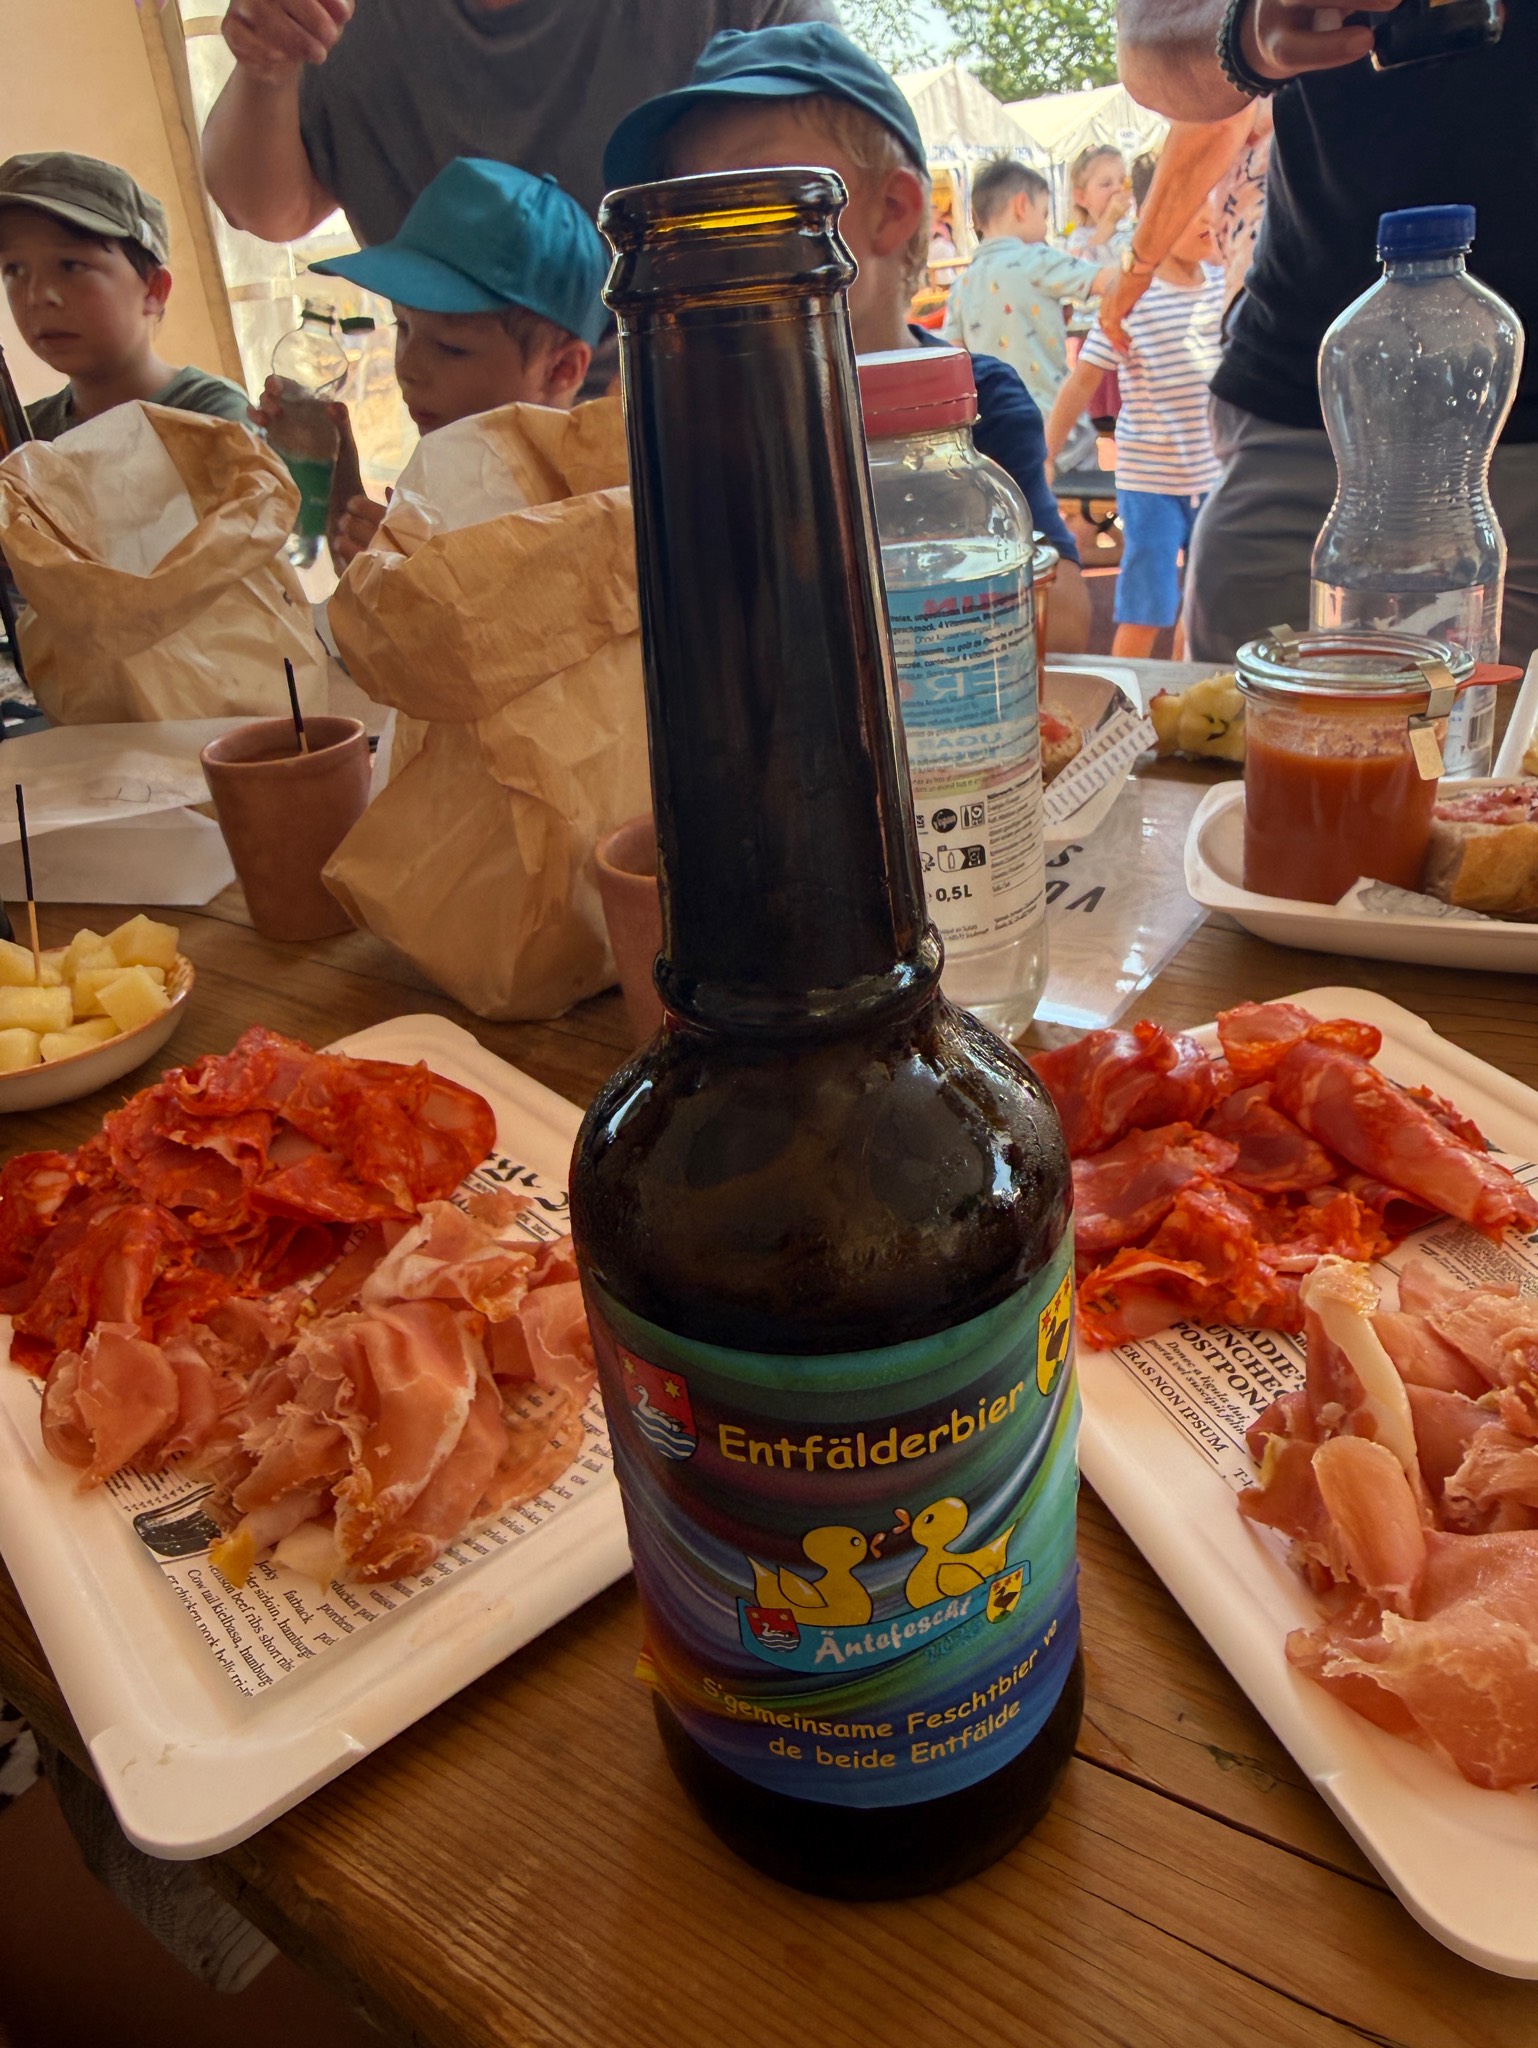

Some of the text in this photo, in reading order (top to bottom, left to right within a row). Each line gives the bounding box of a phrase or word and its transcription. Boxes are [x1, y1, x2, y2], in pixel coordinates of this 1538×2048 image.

[1145, 1339, 1174, 1362] porta
[1172, 1360, 1188, 1379] vel
[1166, 1341, 1195, 1368] Donec
[1200, 1375, 1230, 1402] ligula
[1197, 1319, 1290, 1400] UNCHE
[719, 1381, 1024, 1471] Entfälderbier
[1119, 1344, 1229, 1452] CRAS NON IPSUM
[175, 1587, 202, 1622] chicken
[187, 1569, 207, 1589] Cow
[201, 1589, 221, 1605] tail
[211, 1602, 242, 1649] kielbasa,
[231, 1592, 255, 1612] beef
[245, 1613, 264, 1634] ribs
[259, 1634, 282, 1659] short
[254, 1590, 281, 1621] sirloin,
[283, 1589, 314, 1624] fatback
[814, 1596, 972, 1666] Äntefescht
[703, 1677, 893, 1740] S'gemeinsame
[908, 1650, 1037, 1735] Feschtbier
[769, 1700, 1021, 1769] de beide Entfälde
